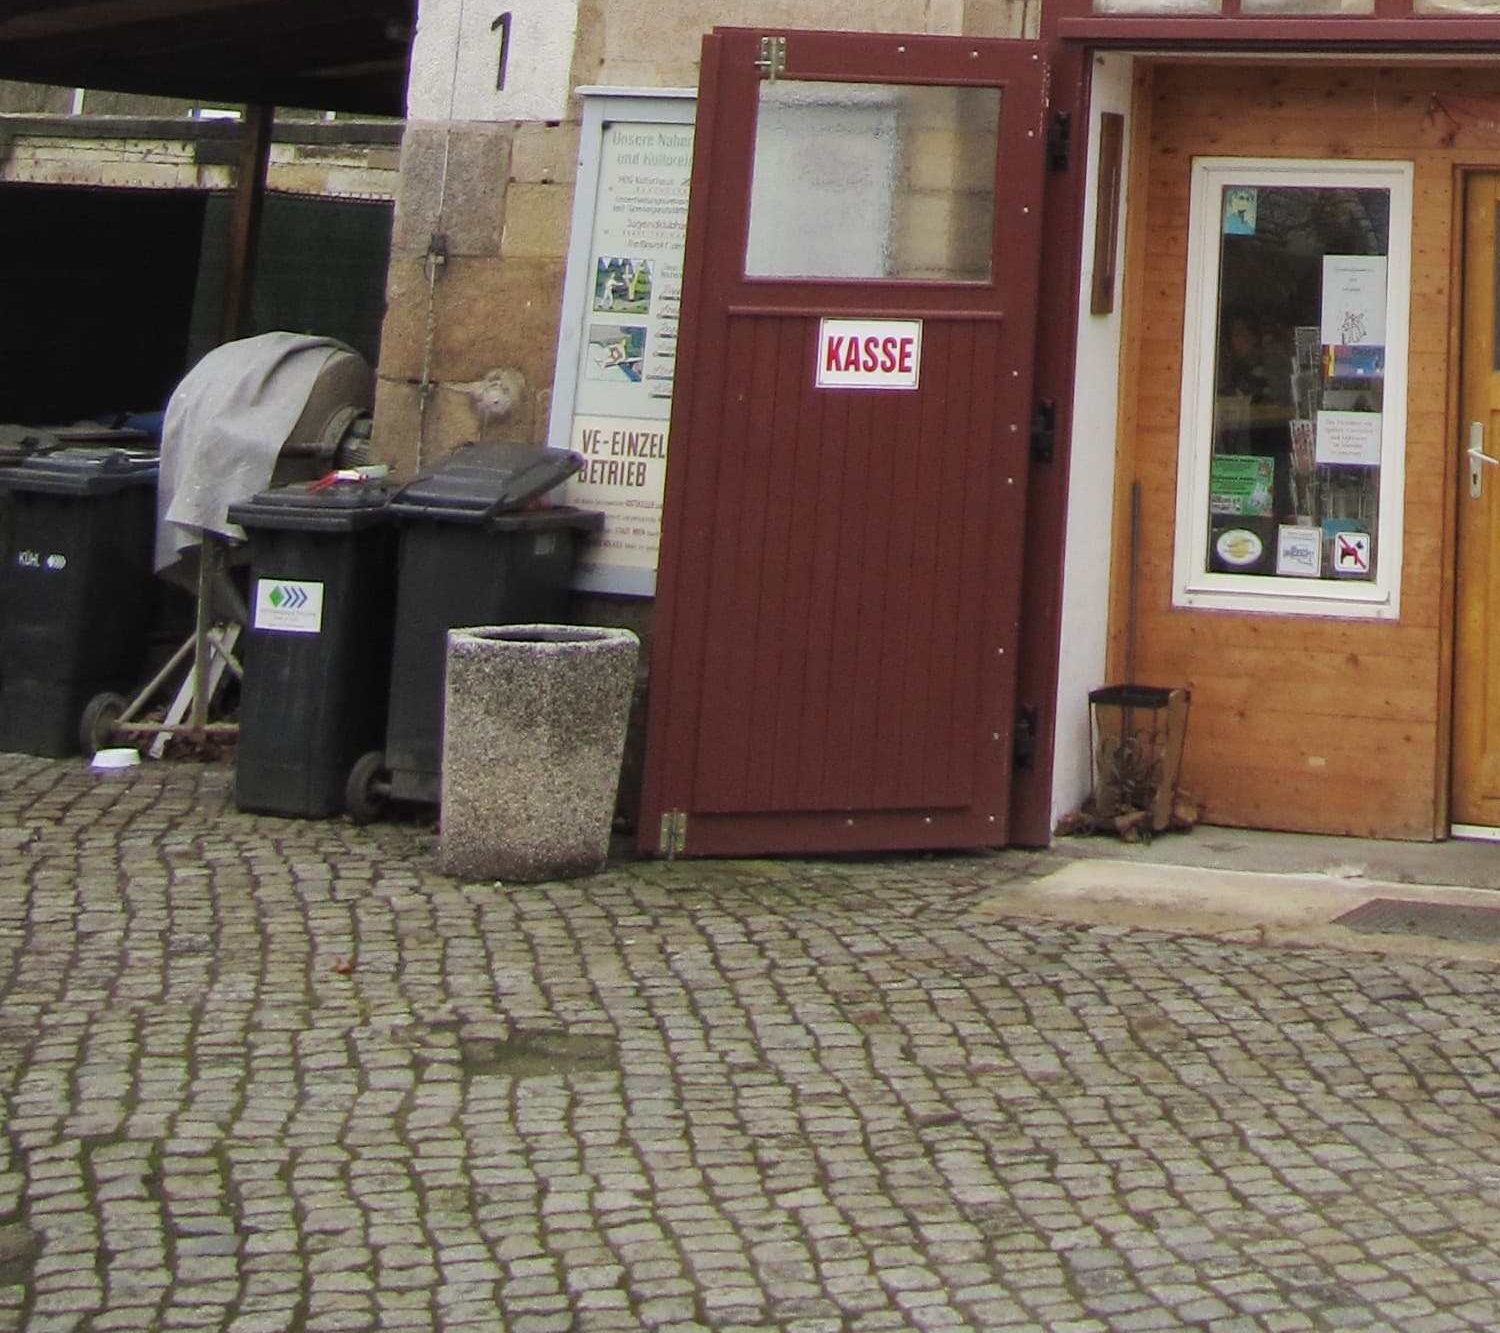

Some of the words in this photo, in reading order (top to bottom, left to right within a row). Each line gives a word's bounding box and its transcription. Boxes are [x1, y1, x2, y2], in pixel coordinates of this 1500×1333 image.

[490, 11, 512, 91] 1
[826, 336, 914, 373] KASSE
[577, 459, 648, 487] BETRIEB
